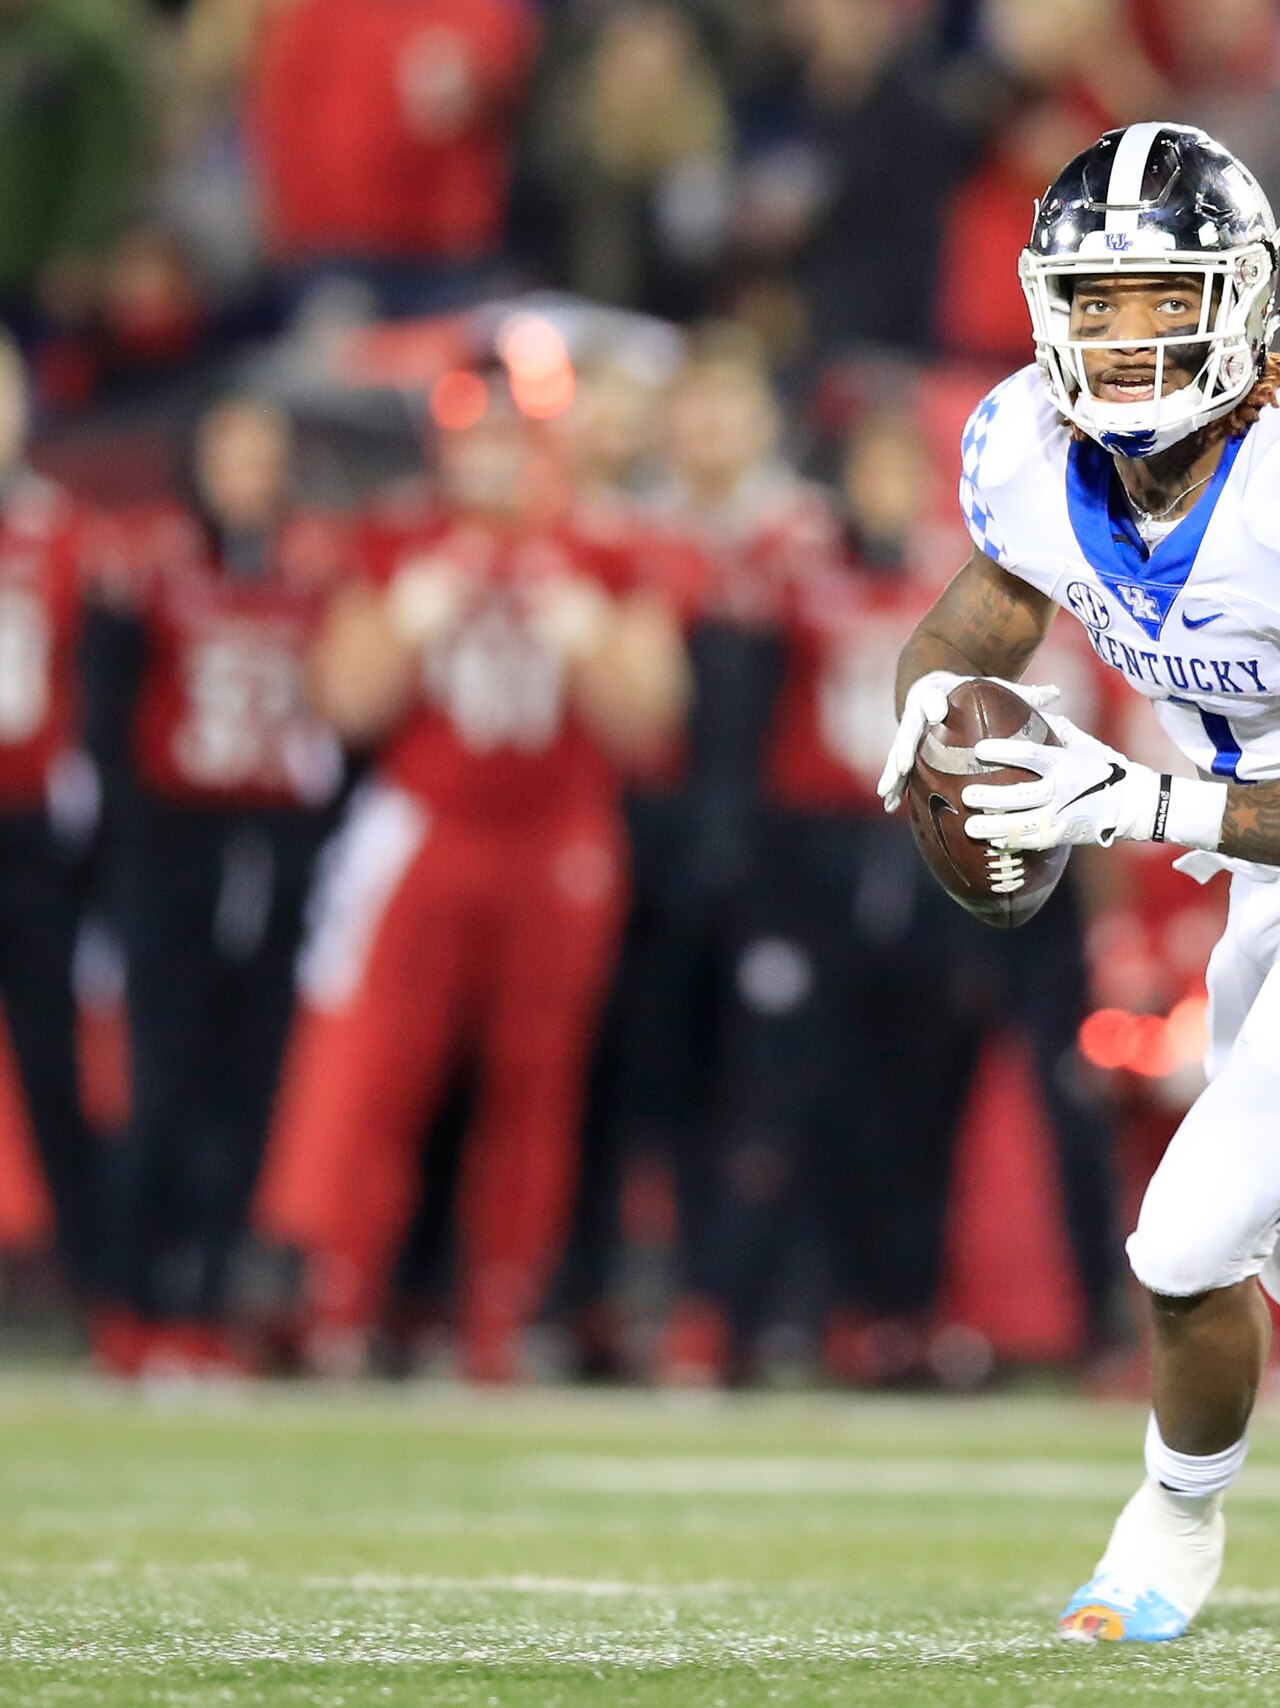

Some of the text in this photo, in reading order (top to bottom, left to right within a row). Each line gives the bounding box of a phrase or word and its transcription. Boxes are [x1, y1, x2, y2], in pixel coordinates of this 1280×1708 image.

[1067, 582, 1110, 630] SEC
[1116, 583, 1161, 622] UK
[1087, 626, 1268, 693] KENTUCKY
[1167, 695, 1258, 785] 1
